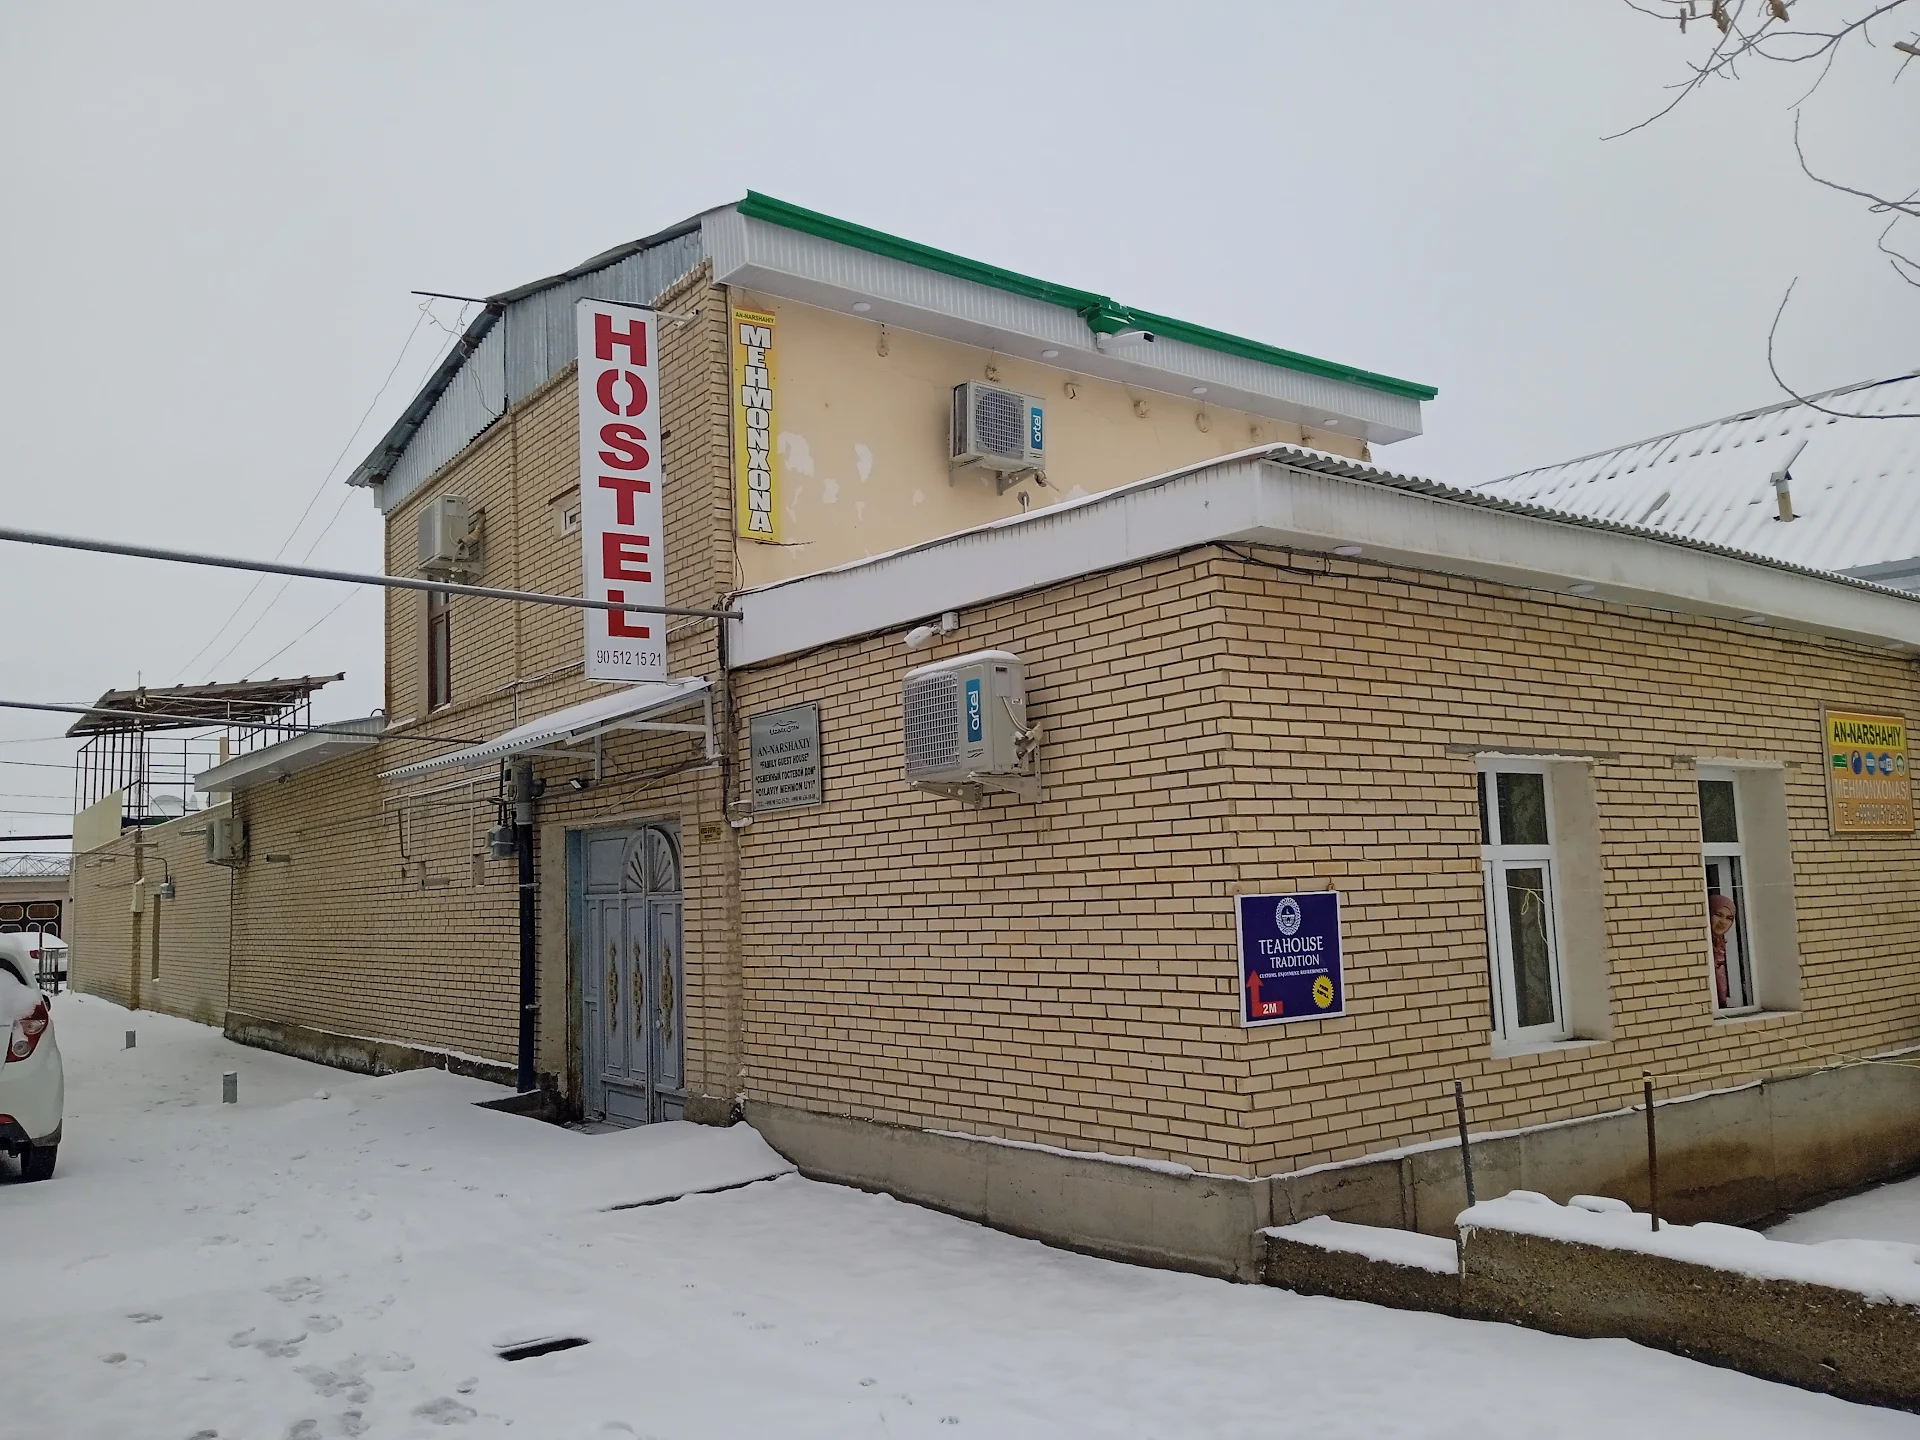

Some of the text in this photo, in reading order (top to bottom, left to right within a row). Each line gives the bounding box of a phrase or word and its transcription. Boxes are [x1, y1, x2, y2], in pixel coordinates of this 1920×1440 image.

[735, 311, 775, 324] AN-NARSHAHIY
[739, 323, 773, 534] MEHMONXONA
[1032, 415, 1042, 443] artel
[594, 312, 652, 639] HOSTEL
[596, 649, 662, 667] 90 512 15 21
[968, 690, 980, 731] artel
[1833, 721, 1902, 747] AN-NARSHAHIY
[757, 736, 812, 758] AN-NARSHAXIY
[1258, 935, 1324, 955] TEAHOUSE
[1270, 953, 1320, 969] TRADITION
[1262, 1002, 1277, 1015] 2M
